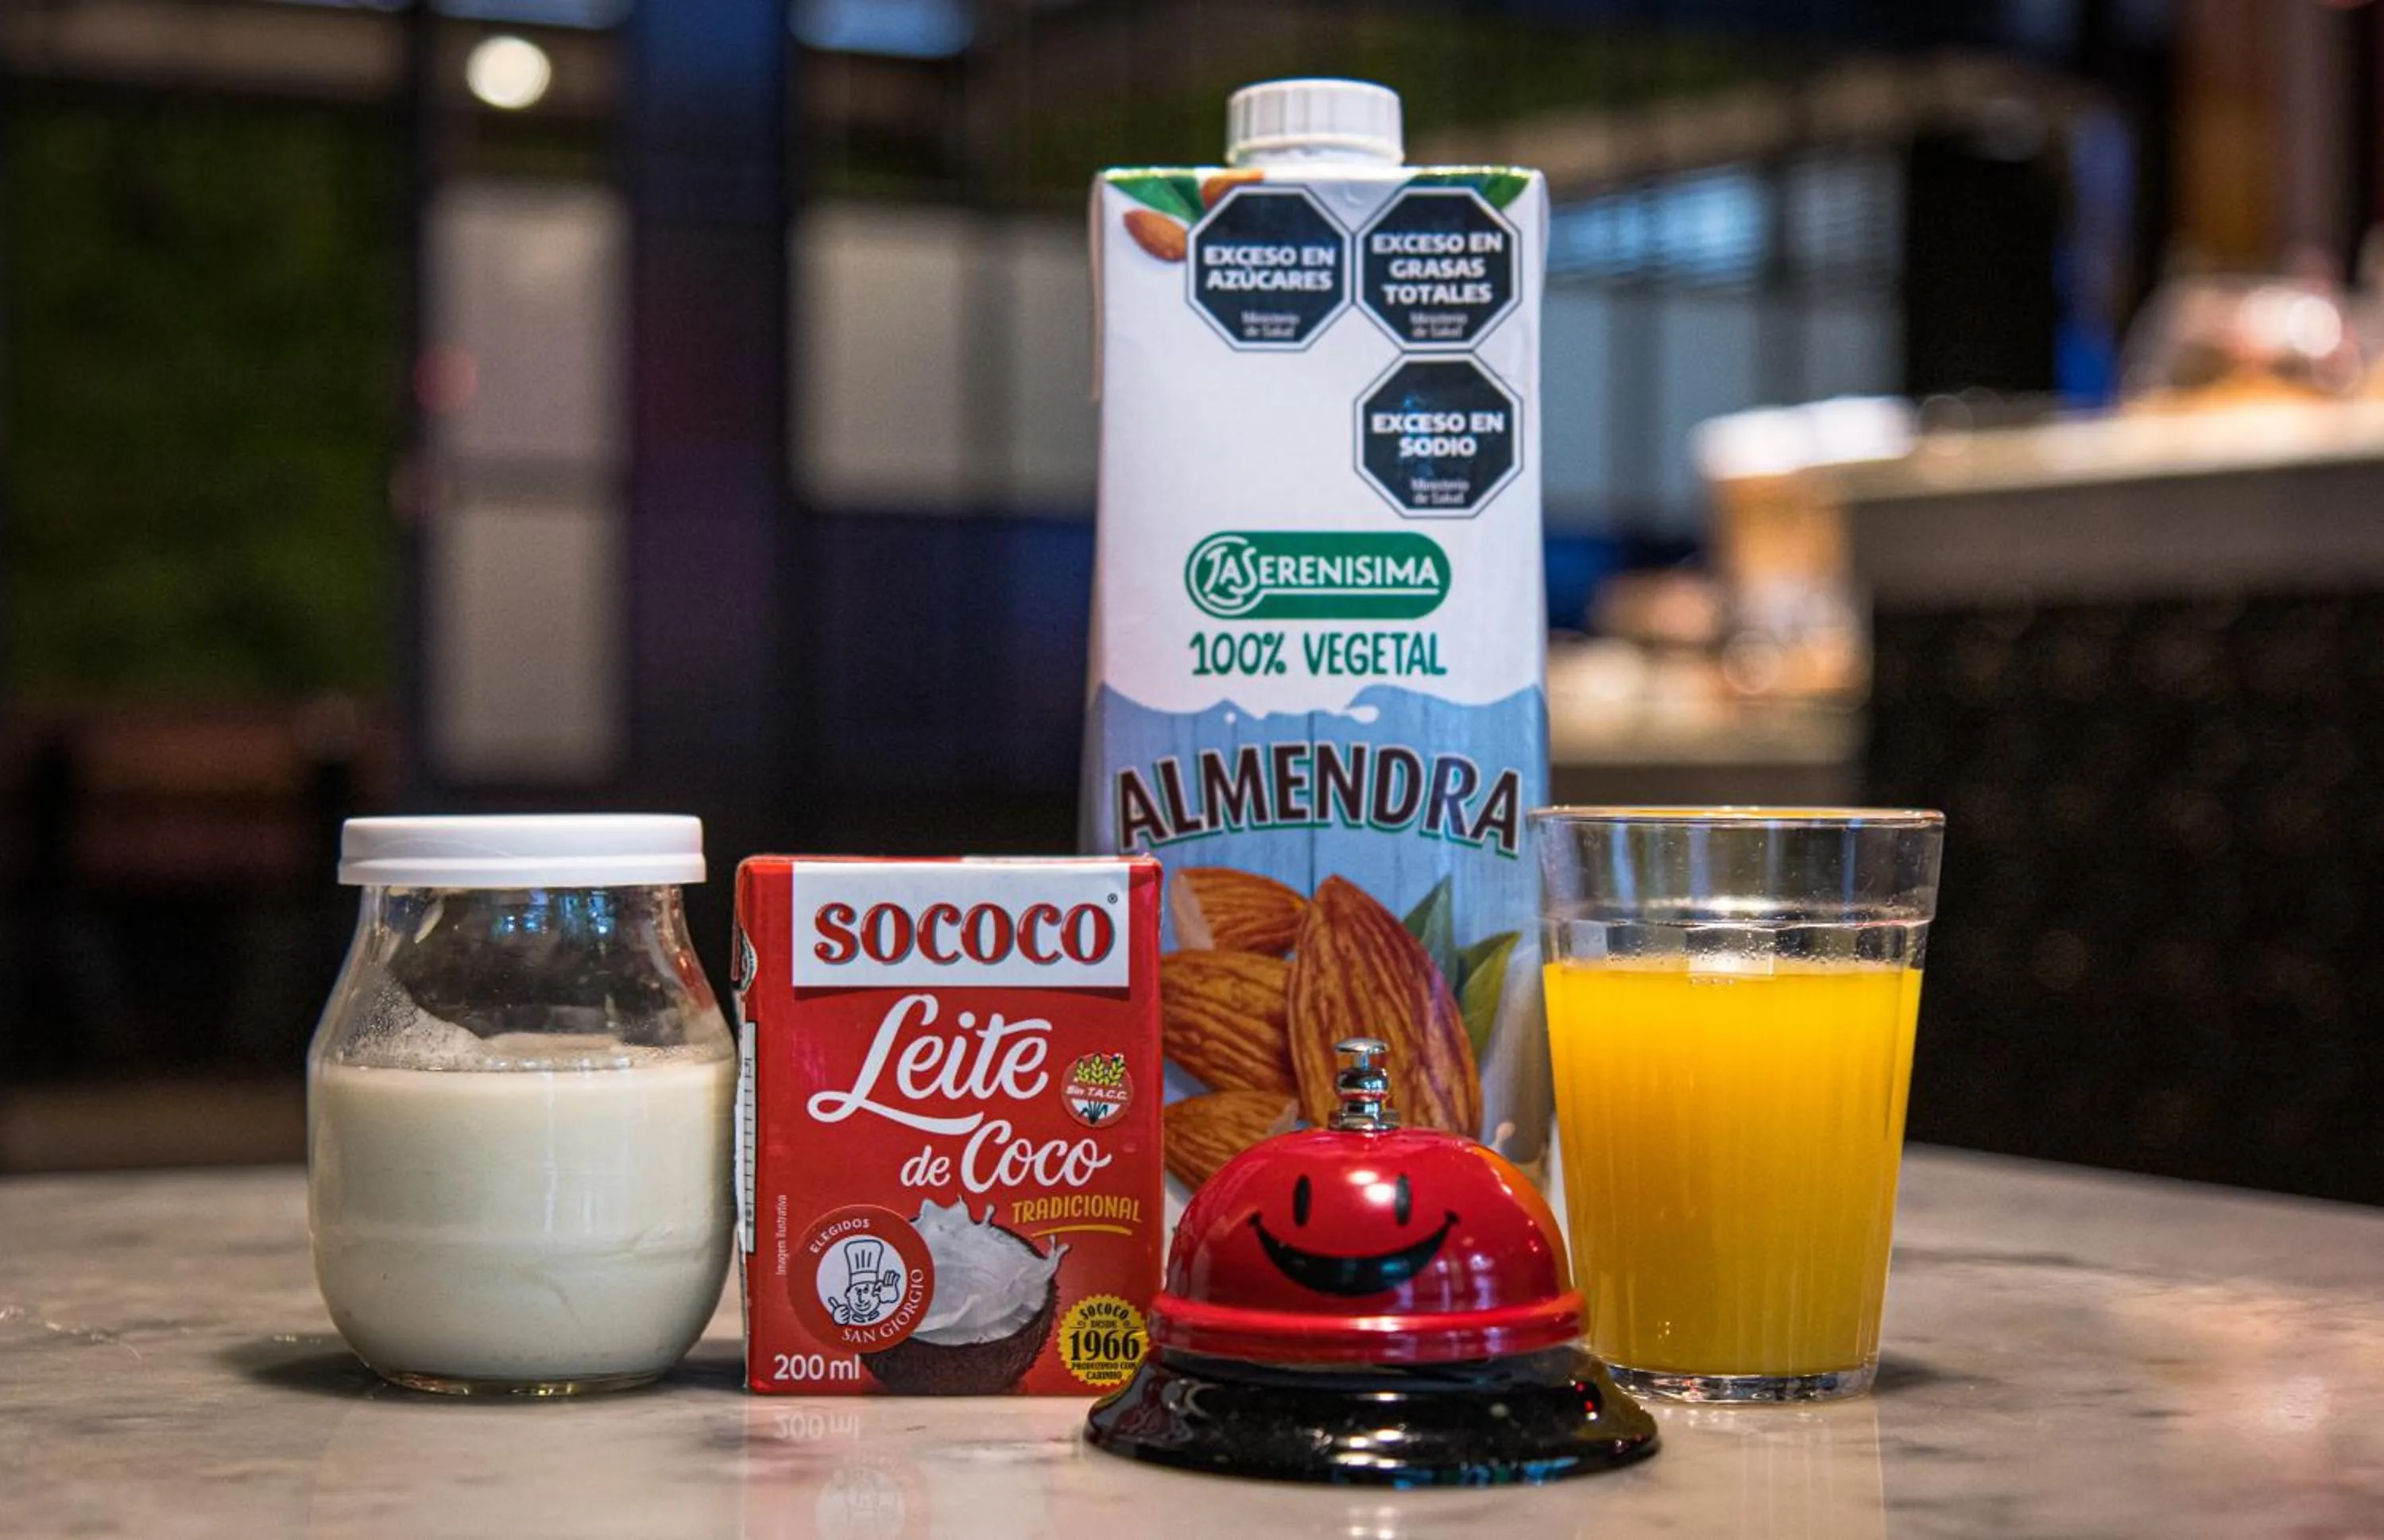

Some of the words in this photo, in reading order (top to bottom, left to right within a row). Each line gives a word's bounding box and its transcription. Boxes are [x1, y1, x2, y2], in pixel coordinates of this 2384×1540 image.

[1203, 246, 1298, 266] EXCESO
[1301, 246, 1336, 266] EN
[1372, 234, 1465, 254] EXCESO
[1469, 232, 1504, 253] EN
[1206, 265, 1333, 290] AZÚCARES
[1389, 258, 1486, 278] GRASAS
[1381, 282, 1493, 304] TOTALES
[1372, 412, 1466, 434] EXCESO
[1470, 412, 1504, 433] EN
[1399, 438, 1477, 458] SODIO
[1189, 632, 1287, 675] 100%
[1303, 632, 1448, 675] VEGETAL
[1116, 741, 1523, 858] ALMENDRA
[813, 903, 1116, 965] SOCOCO
[807, 994, 1053, 1135] Leite
[900, 1145, 950, 1186] de
[960, 1120, 1112, 1194] Coco
[1011, 1194, 1143, 1225] TRADICIONAL
[809, 1217, 871, 1254] ELEGIDOS
[842, 1328, 877, 1343] SAN
[880, 1268, 924, 1337] GIORGIO
[1079, 1302, 1130, 1320] SOCOCO
[1068, 1329, 1140, 1361] 1966
[774, 1353, 825, 1380] 200
[830, 1353, 861, 1380] ml
